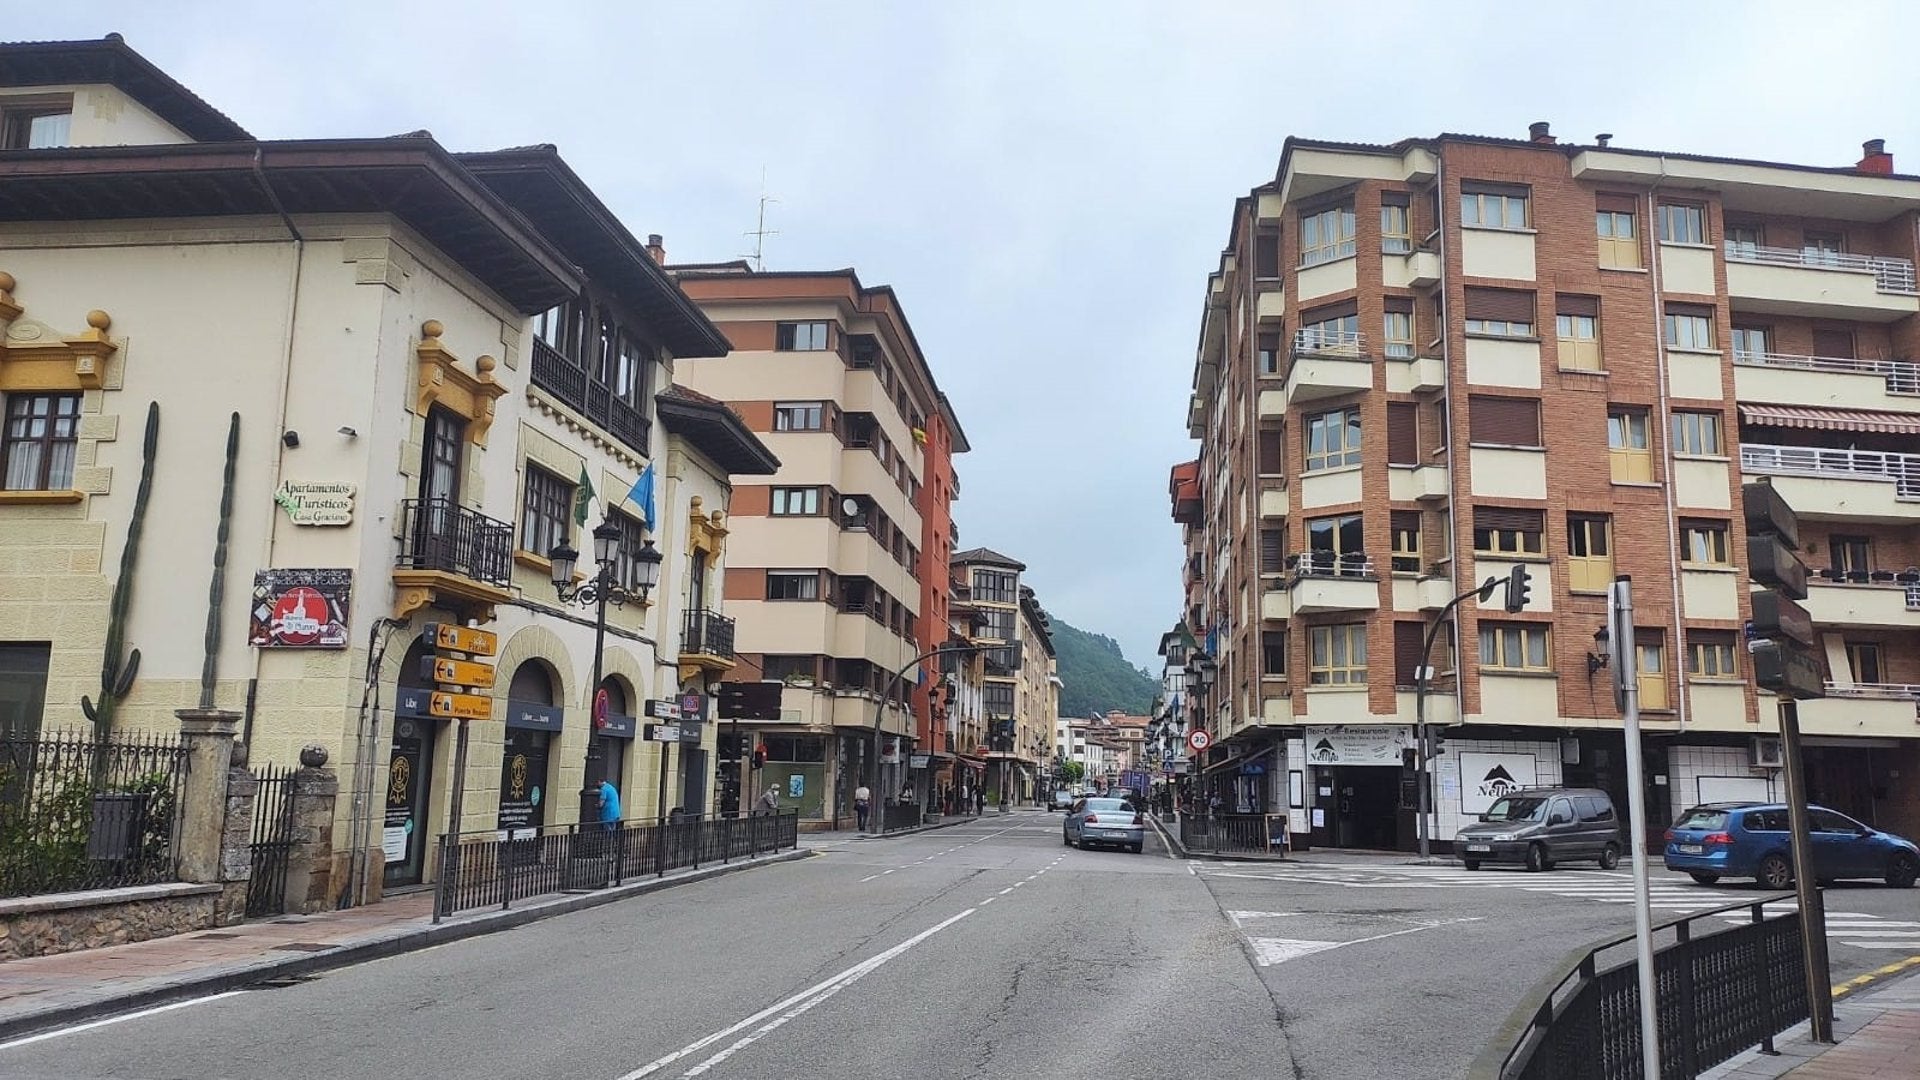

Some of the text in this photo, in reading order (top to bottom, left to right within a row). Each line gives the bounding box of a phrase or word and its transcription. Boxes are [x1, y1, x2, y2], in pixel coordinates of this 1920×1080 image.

[283, 480, 350, 497] Apartamentos
[295, 495, 348, 509] Turísticos
[294, 511, 312, 521] Casa
[1194, 736, 1205, 744] 30
[1164, 749, 1172, 758] P
